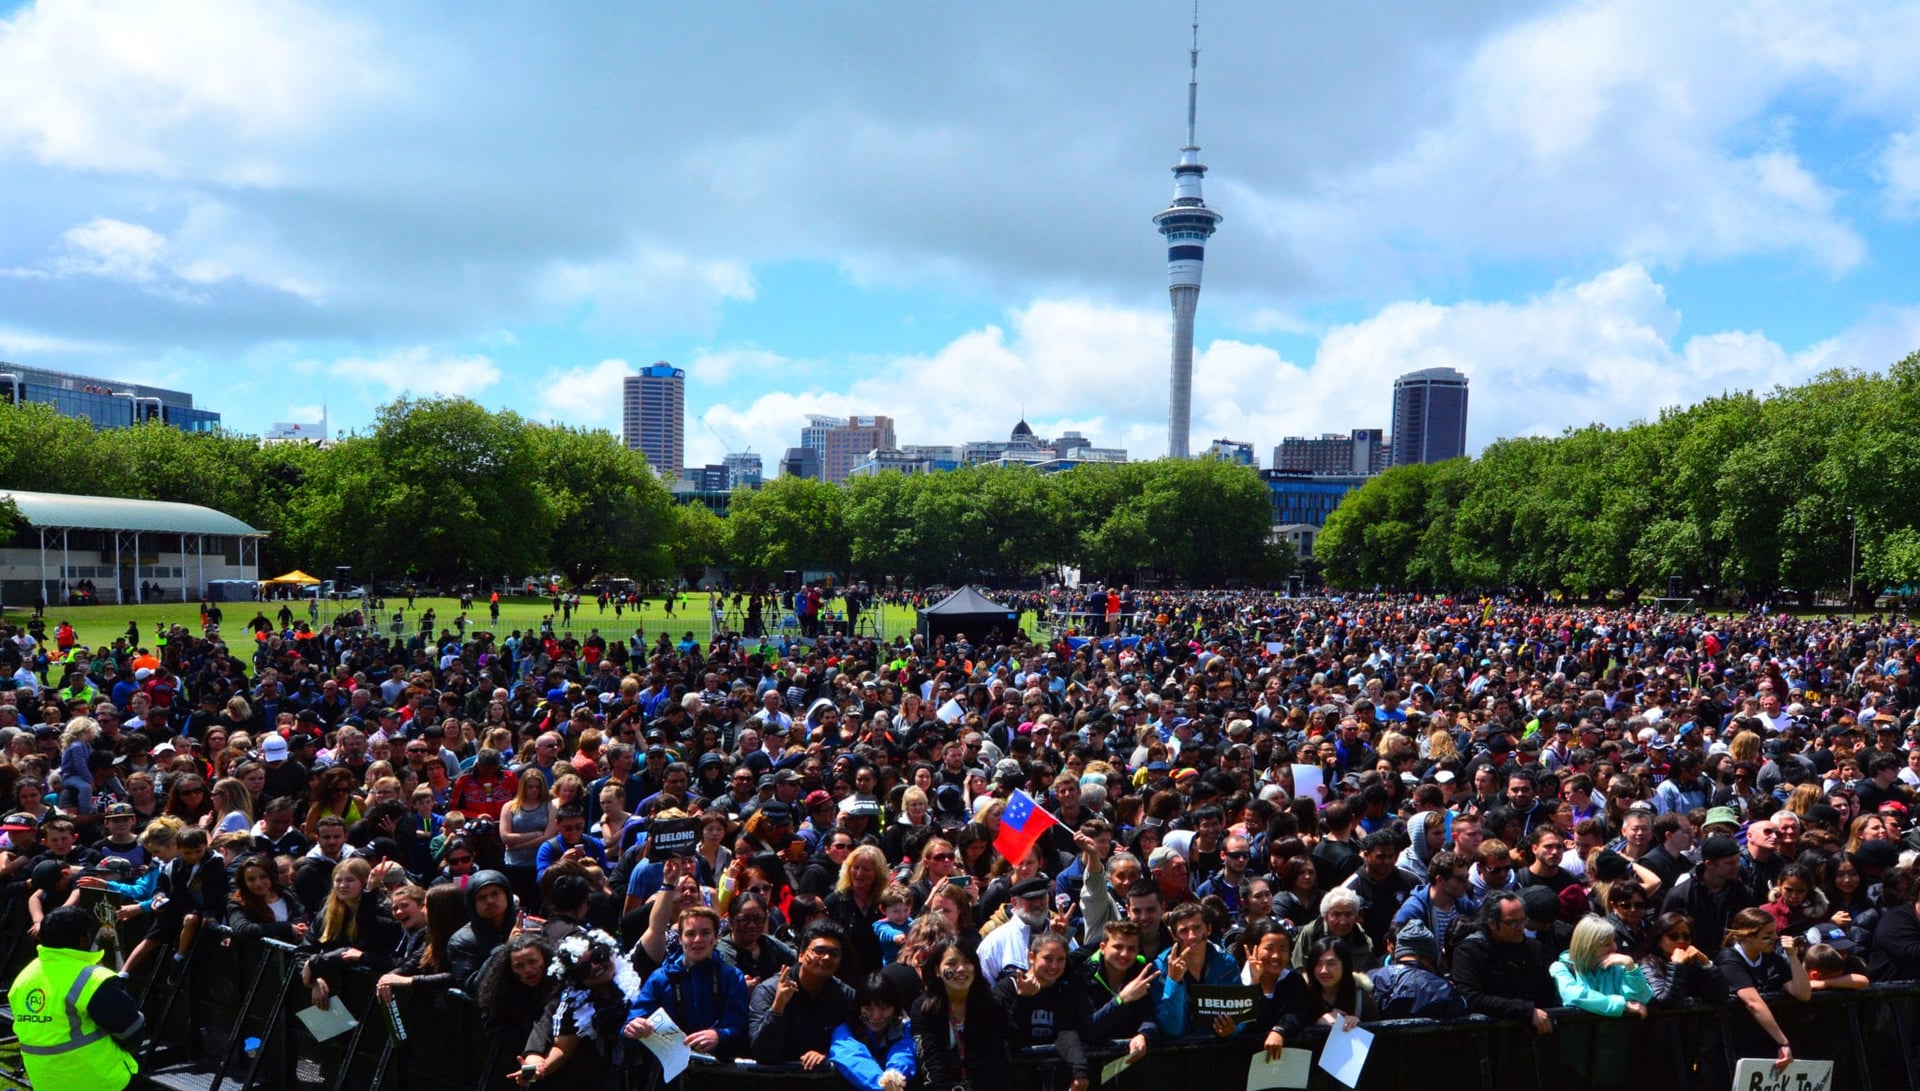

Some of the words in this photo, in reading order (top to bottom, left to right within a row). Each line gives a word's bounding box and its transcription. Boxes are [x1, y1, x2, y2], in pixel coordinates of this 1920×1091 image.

[655, 834, 660, 843] I
[660, 830, 695, 843] BELONG
[1197, 998, 1203, 1007] I
[1204, 998, 1253, 1008] BELONG
[17, 1014, 53, 1023] GROUP
[1749, 1071, 1790, 1091] Back
[1796, 1072, 1812, 1091] To
